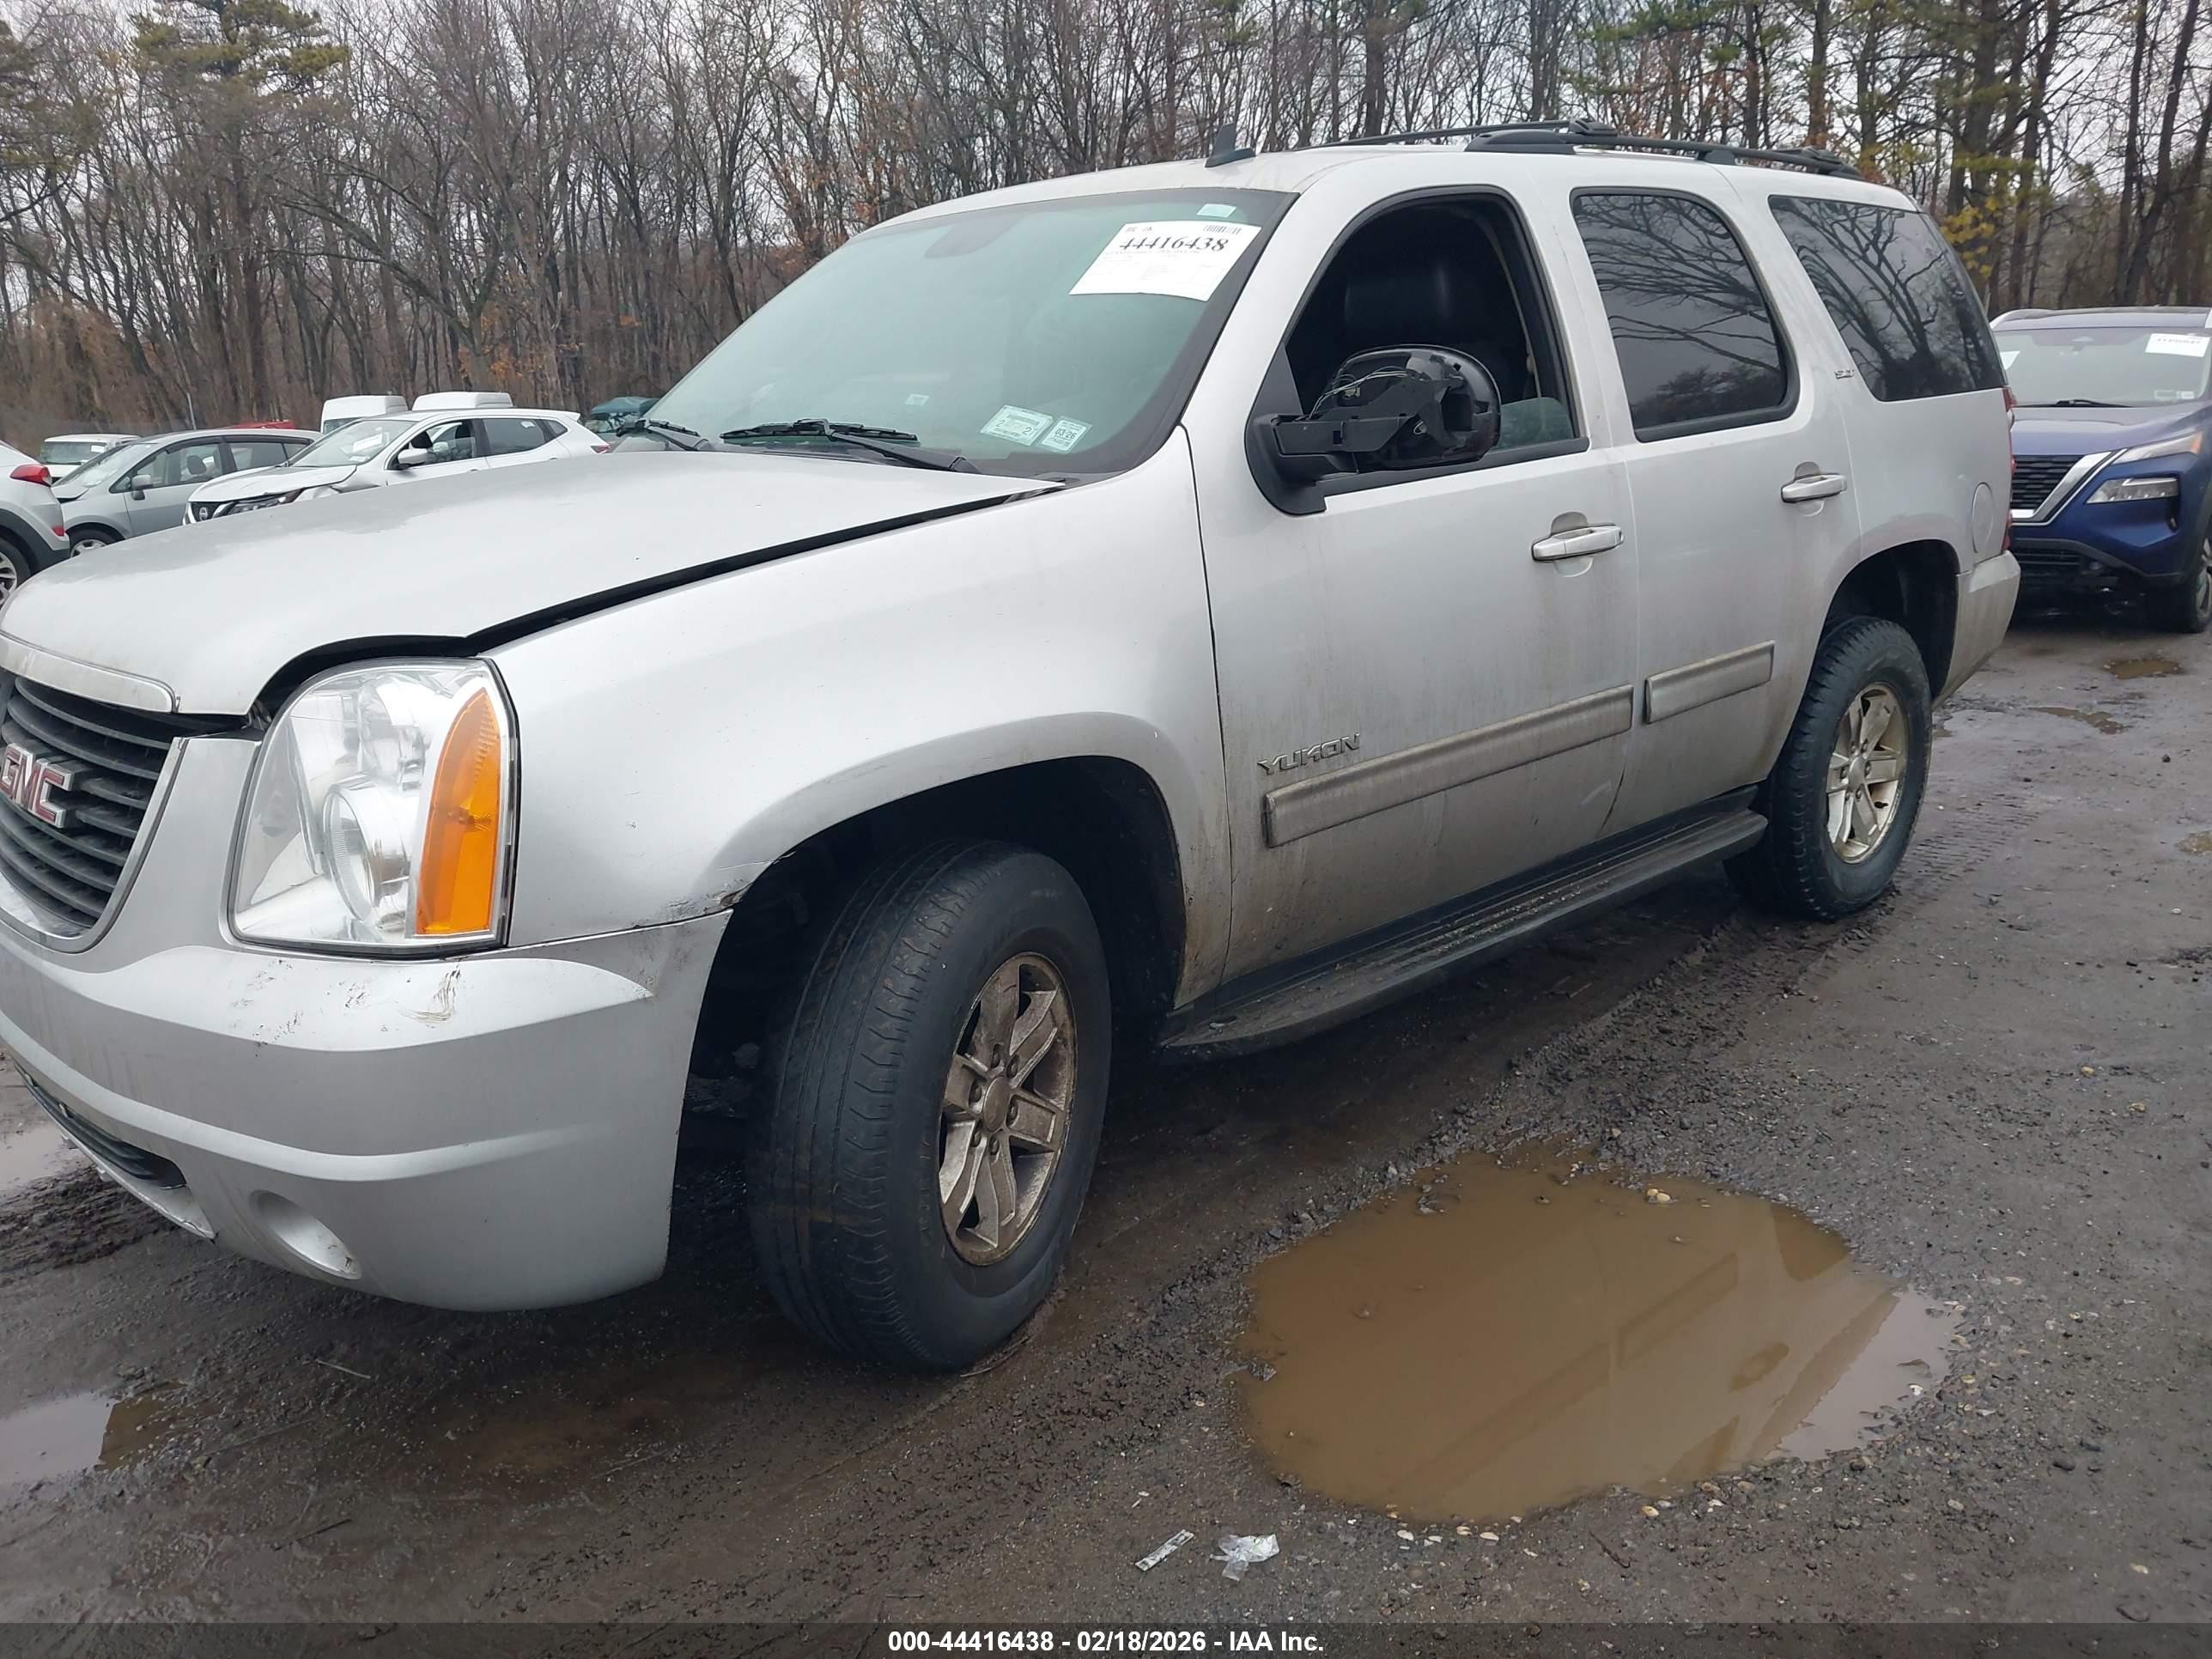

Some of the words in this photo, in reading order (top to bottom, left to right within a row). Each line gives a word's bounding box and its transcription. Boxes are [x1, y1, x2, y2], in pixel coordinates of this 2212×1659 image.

[1119, 235, 1229, 252] 44416438
[1257, 733, 1360, 775] YUKON
[0, 743, 75, 829] GMC
